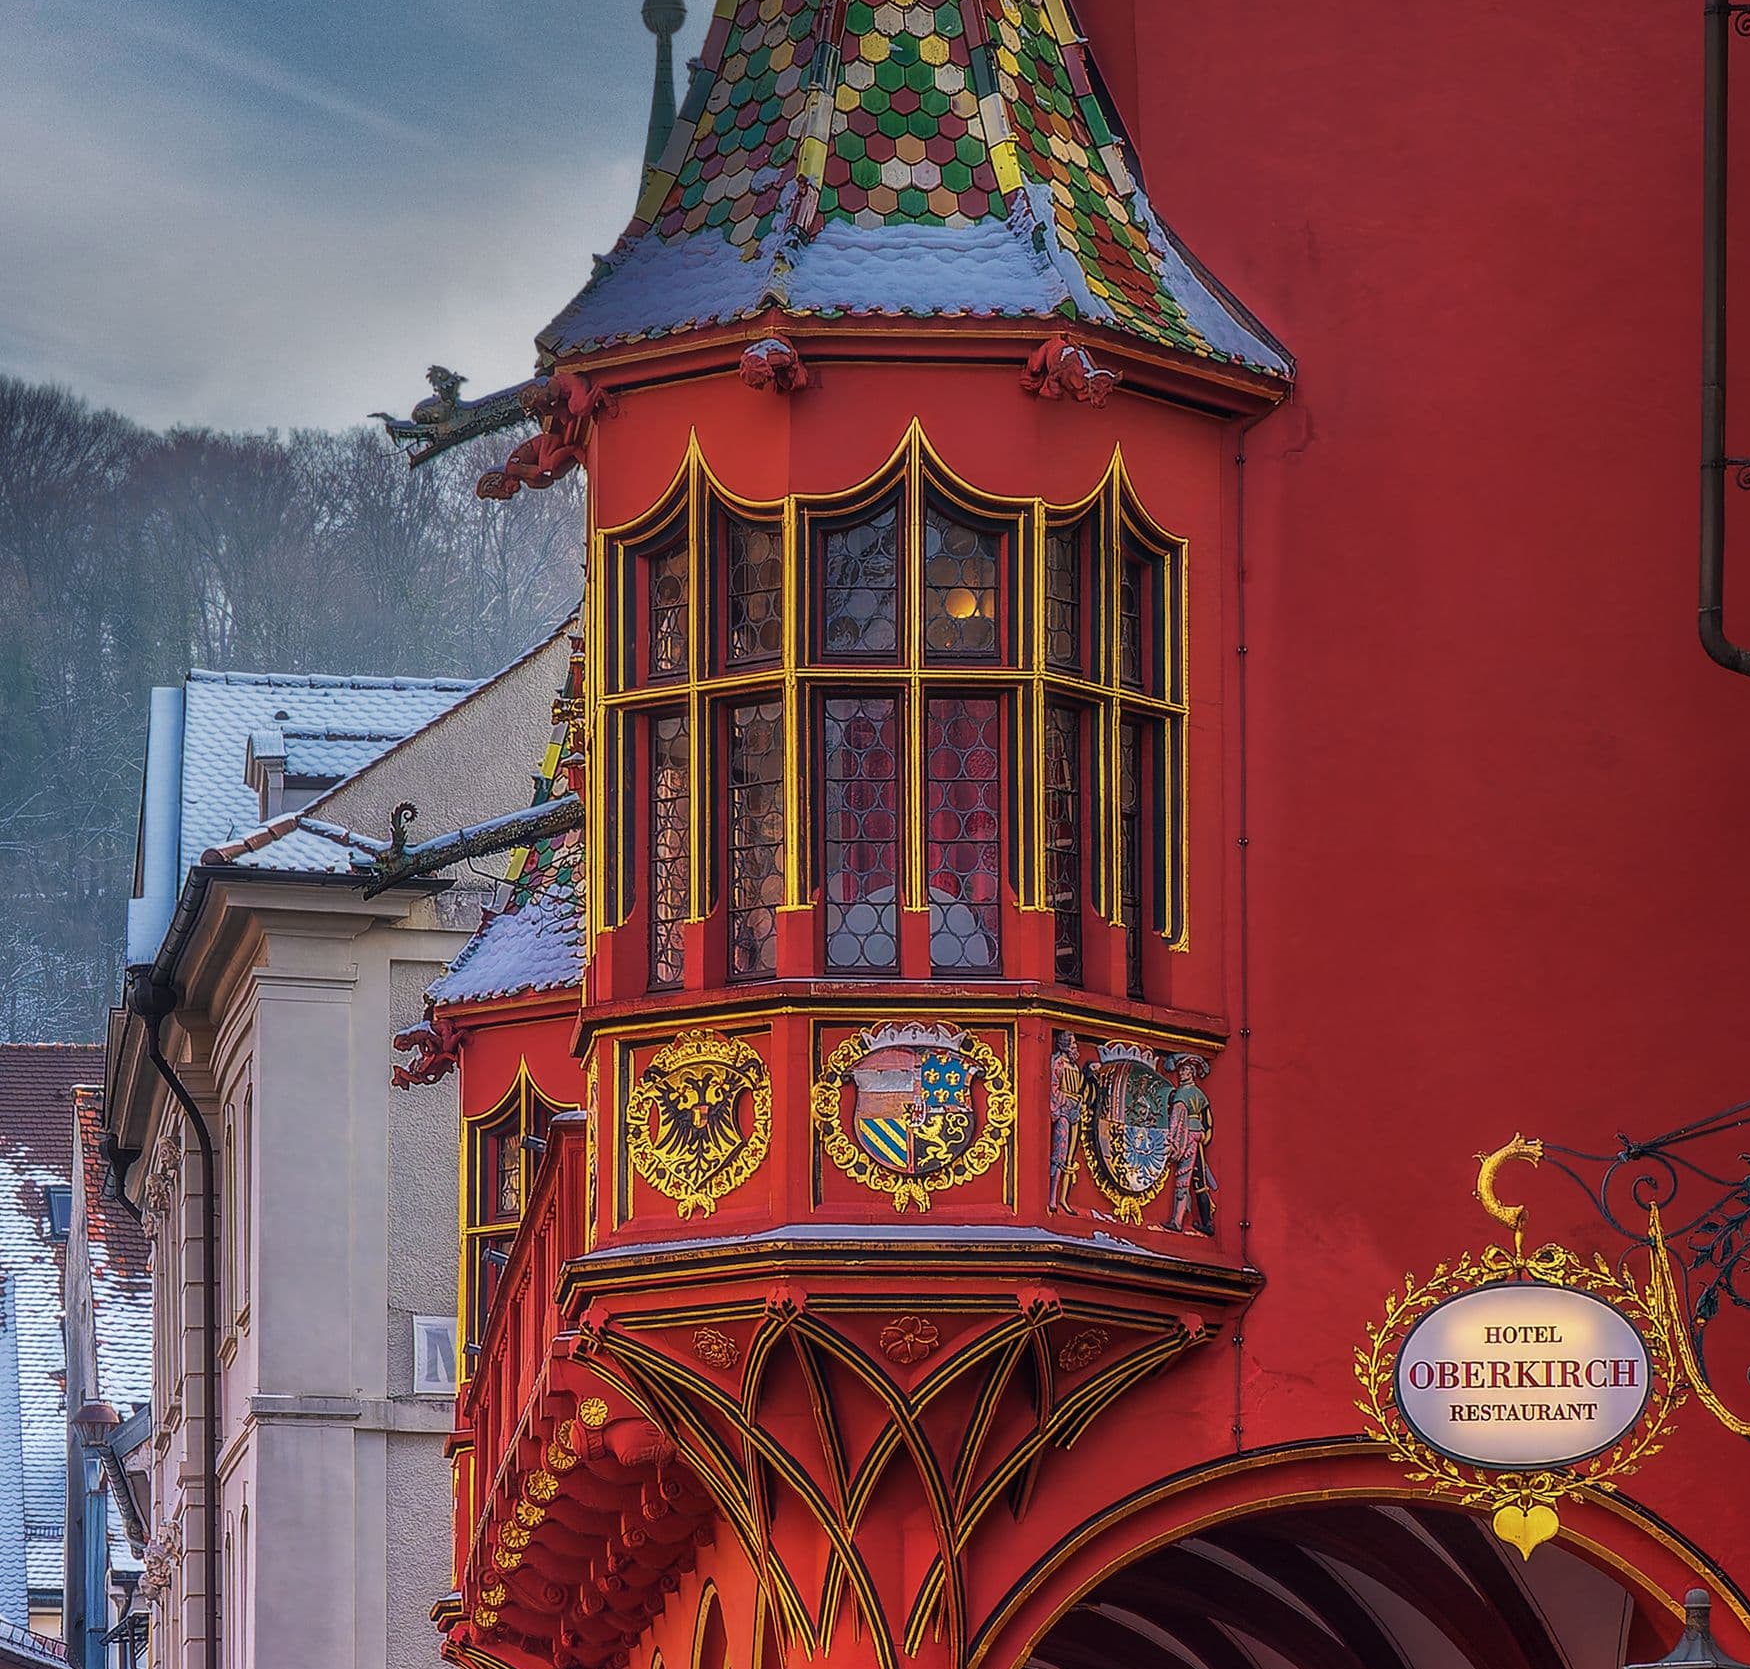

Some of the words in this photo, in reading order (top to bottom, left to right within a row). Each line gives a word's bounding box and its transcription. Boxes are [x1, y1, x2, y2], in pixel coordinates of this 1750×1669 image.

[1483, 1325, 1563, 1345] HOTEL
[1408, 1358, 1639, 1390] OBERKIRCH
[1448, 1402, 1598, 1422] RESTAURANT
